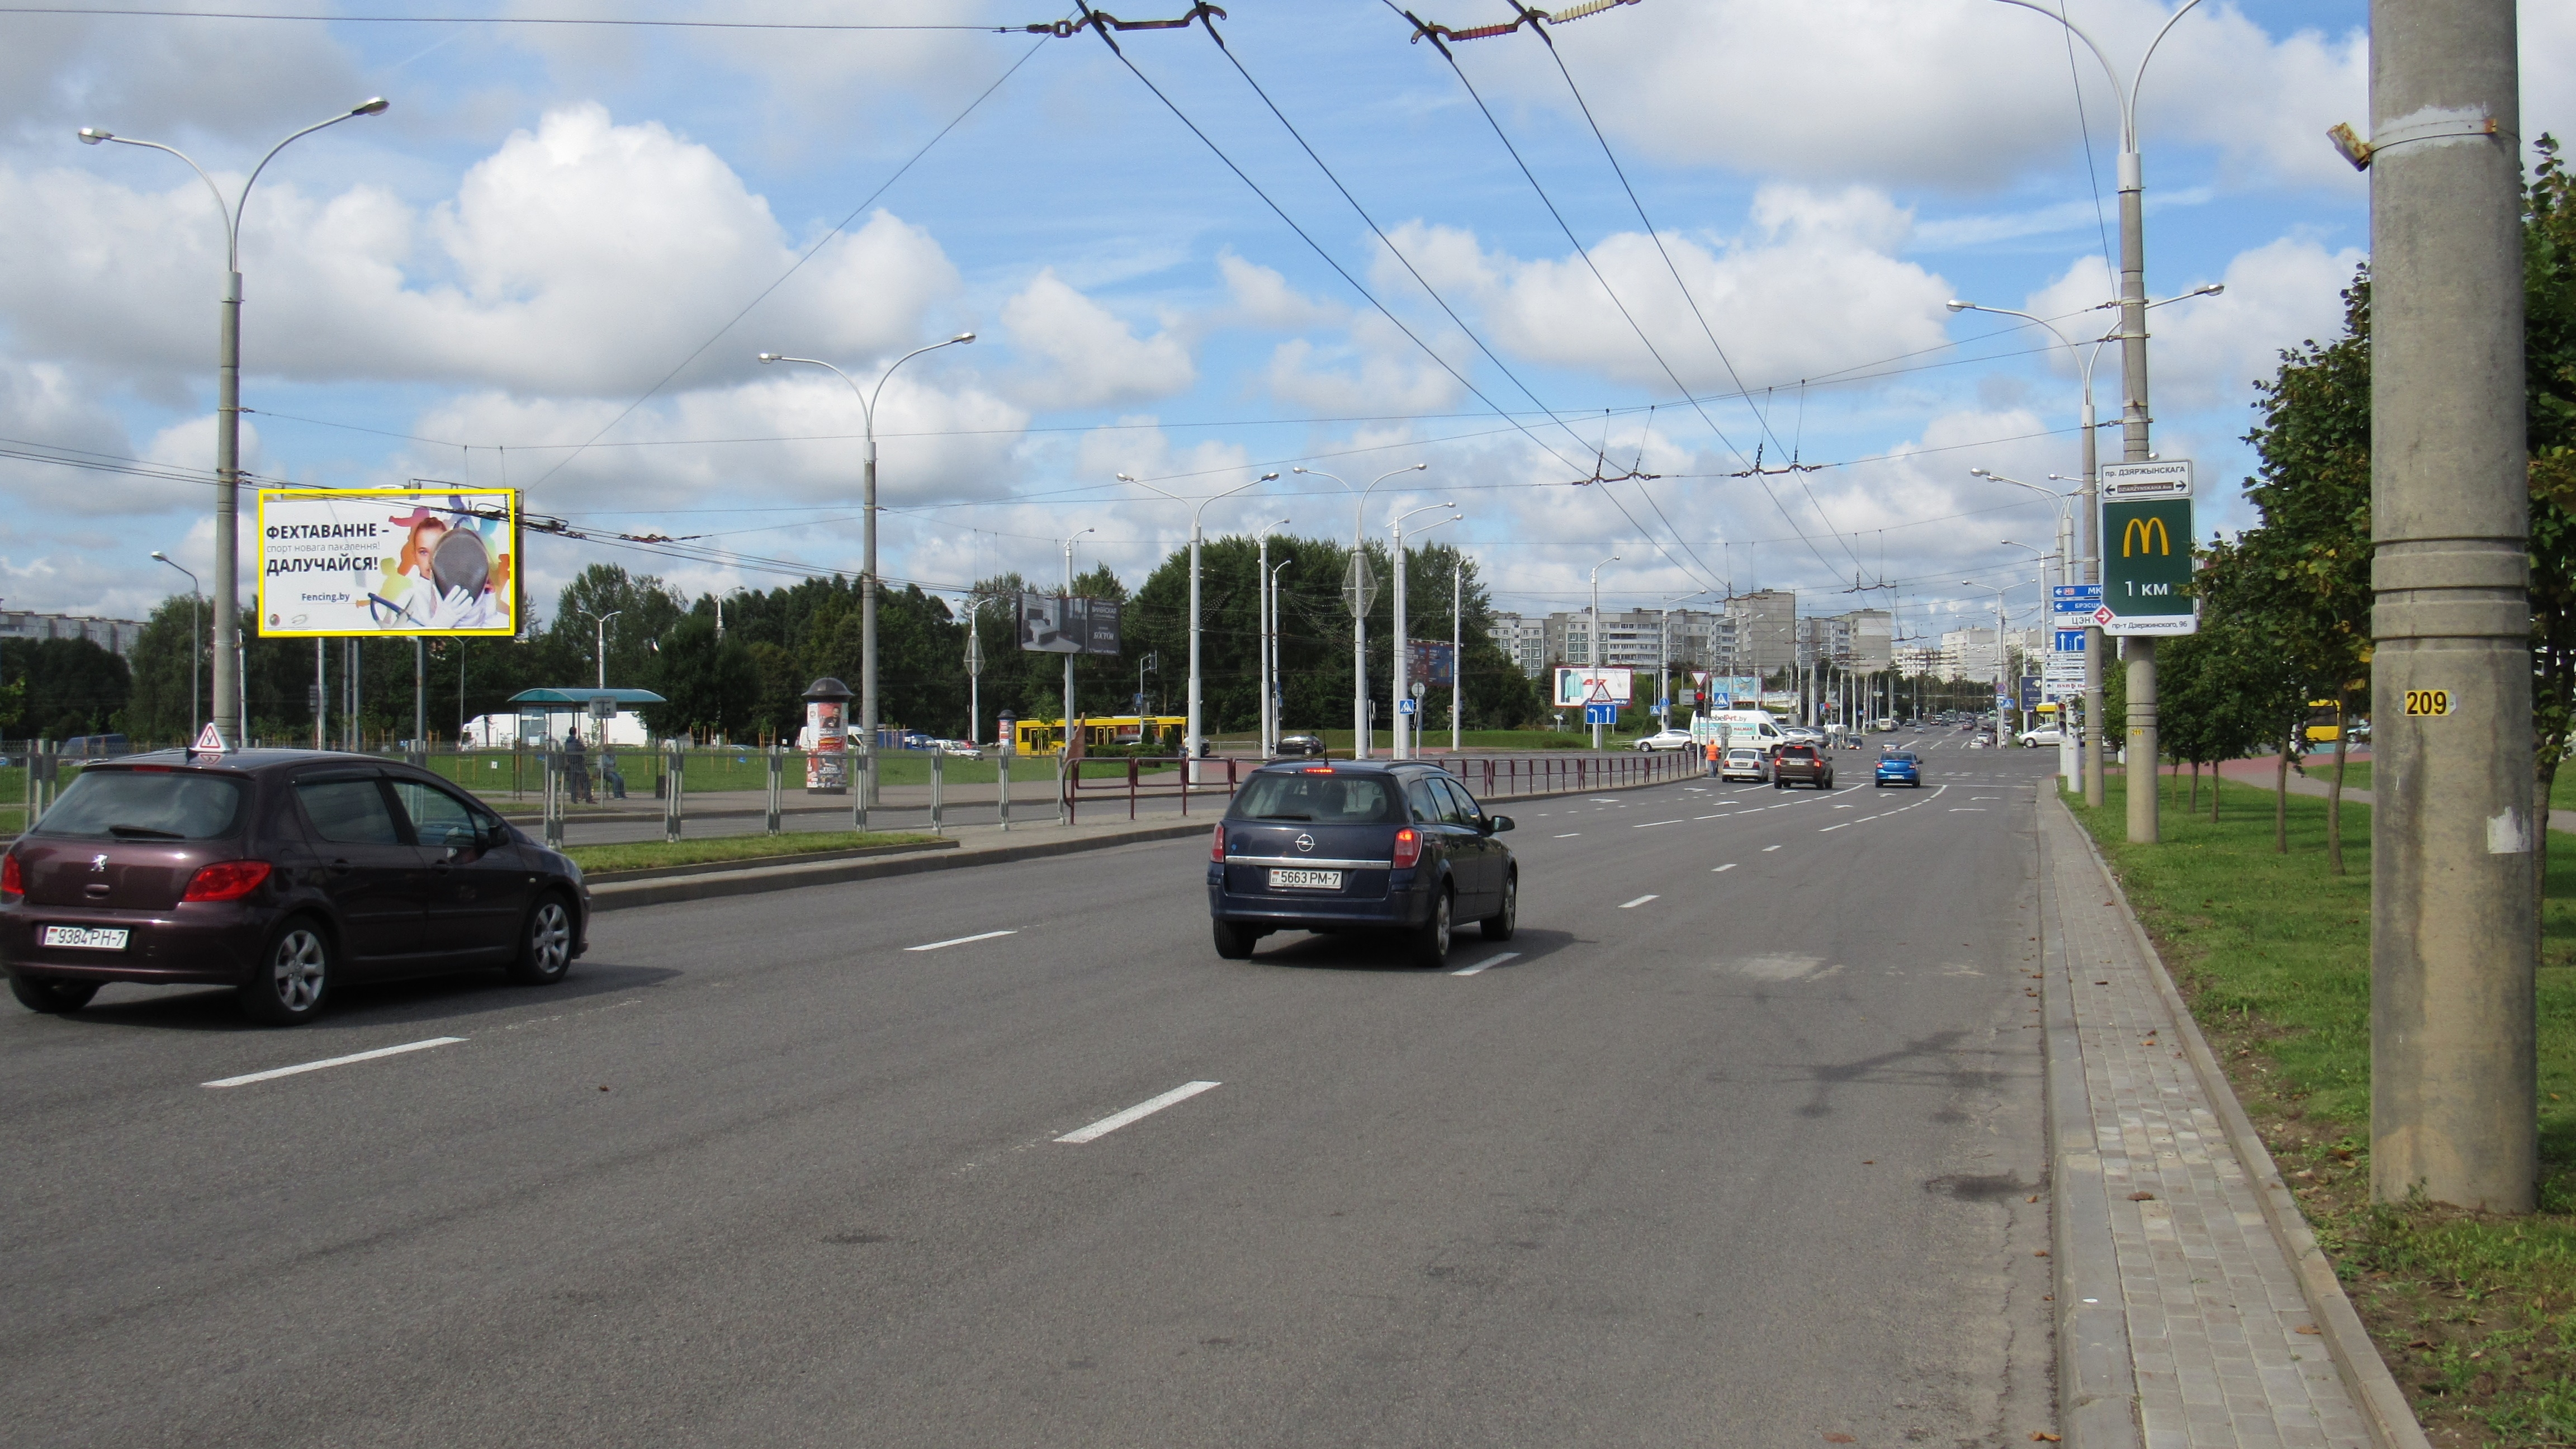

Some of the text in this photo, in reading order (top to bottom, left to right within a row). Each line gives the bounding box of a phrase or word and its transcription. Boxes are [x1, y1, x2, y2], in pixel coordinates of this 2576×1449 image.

[2119, 466, 2185, 476] ДЗЯРЖЫНСКАГА
[266, 523, 377, 539] ФЕХТАВАННЕ
[267, 541, 381, 554] спорт новага пакалення!
[266, 553, 378, 576] ДАЛУЧАЙСЯ!
[2125, 580, 2168, 596] 1 км
[302, 592, 350, 602] Fencing.by
[2406, 692, 2447, 714] 209
[1281, 871, 1308, 883] 5663
[1310, 873, 1339, 885] PM-7
[58, 929, 87, 945] 9384
[90, 930, 126, 946] PH-7
